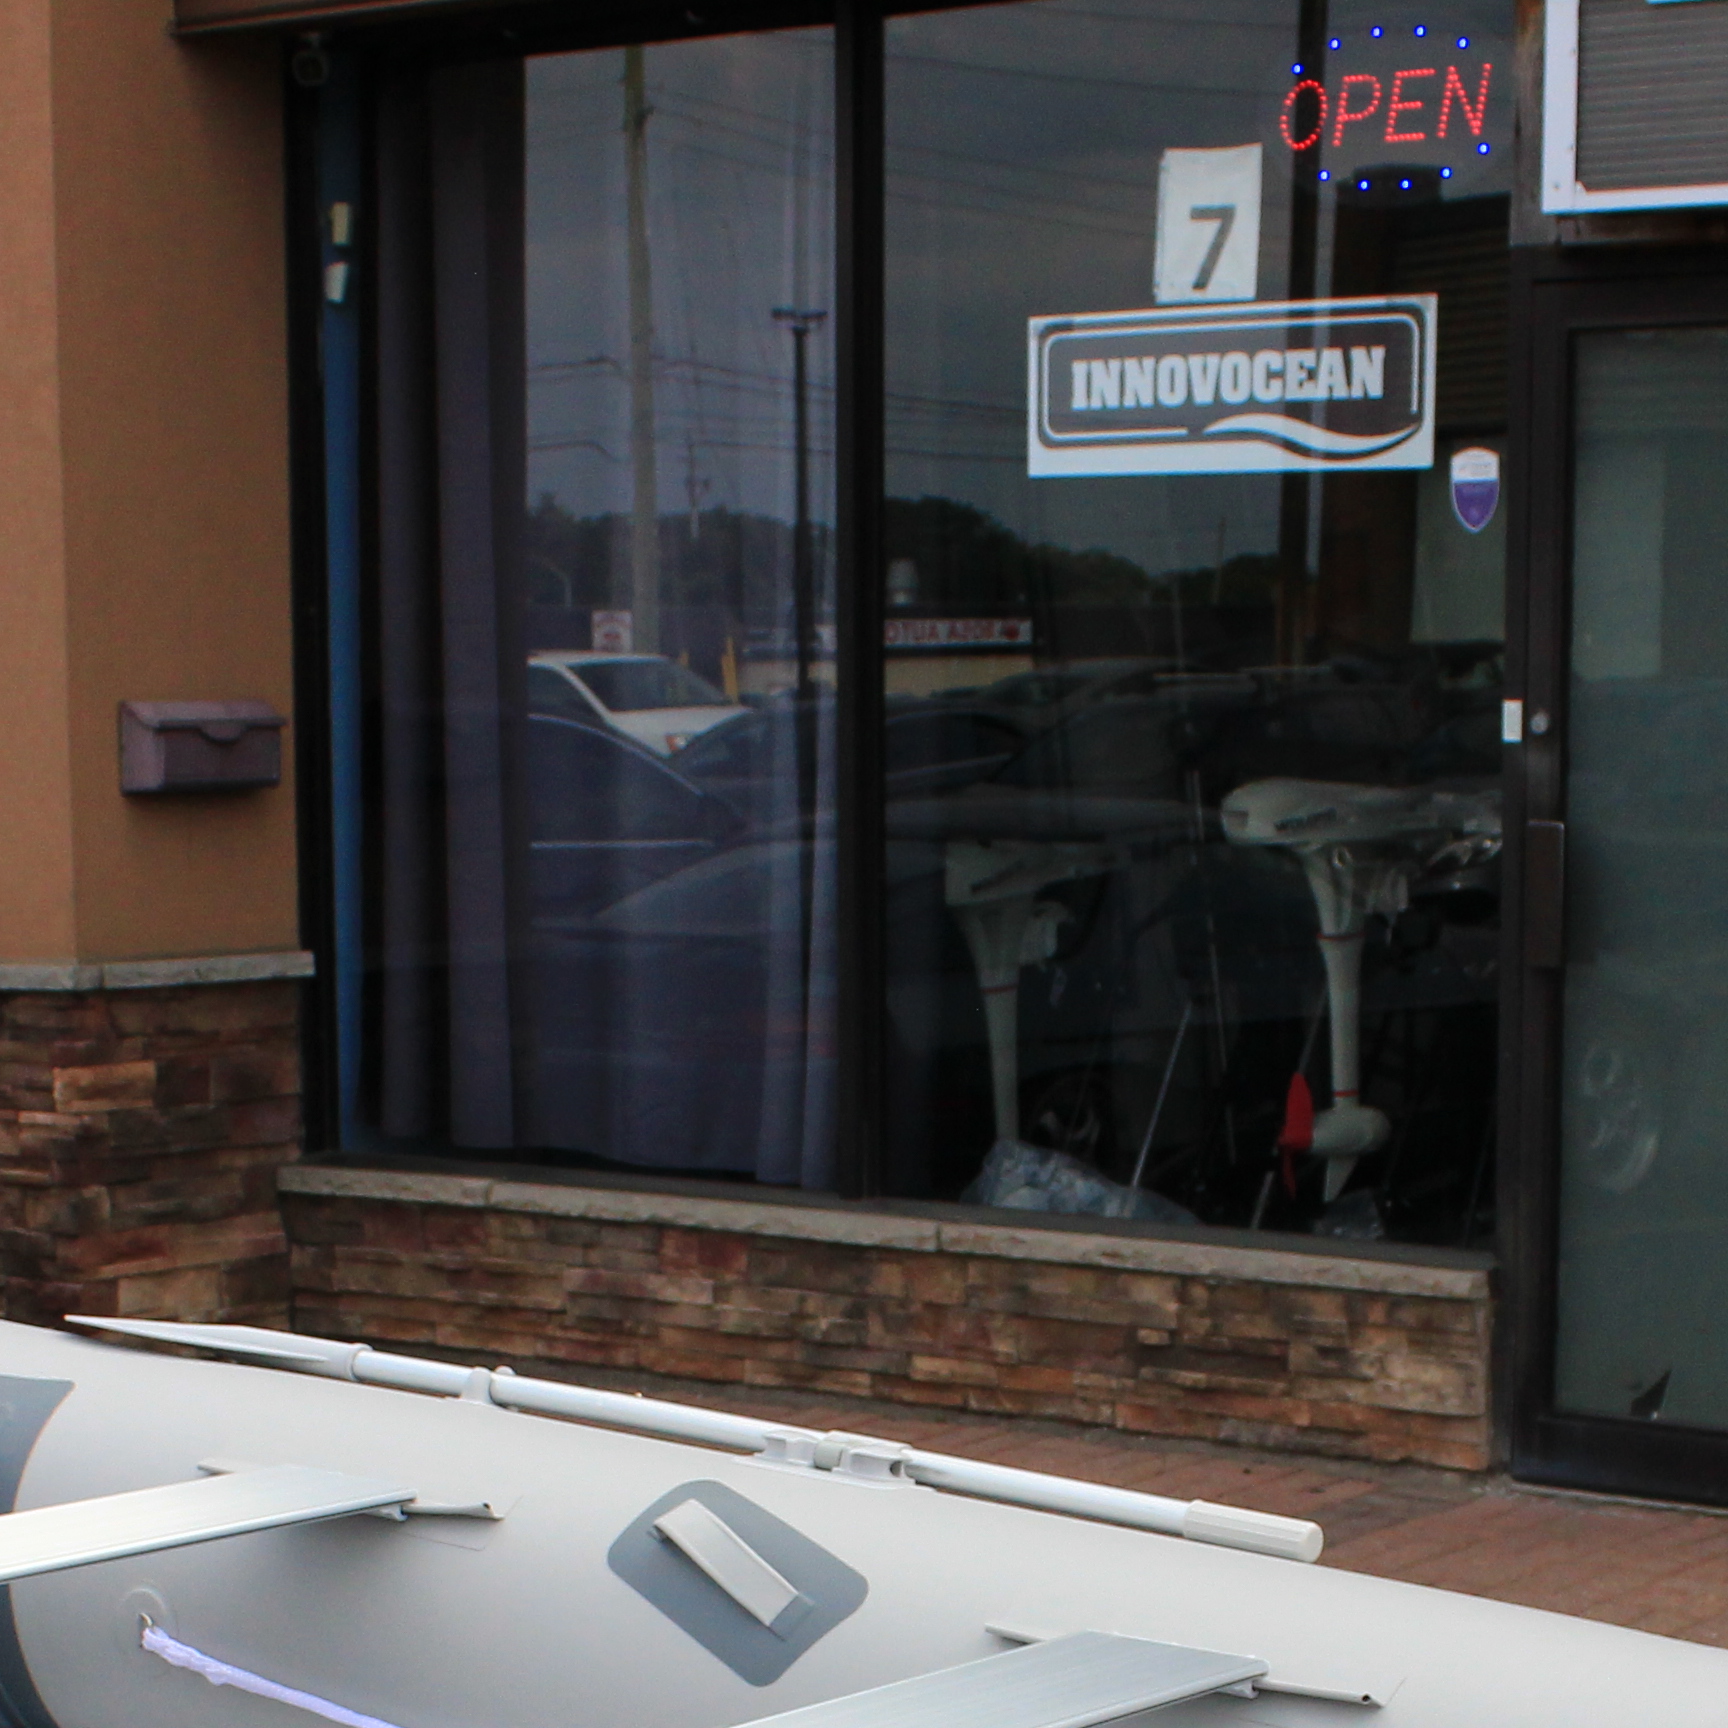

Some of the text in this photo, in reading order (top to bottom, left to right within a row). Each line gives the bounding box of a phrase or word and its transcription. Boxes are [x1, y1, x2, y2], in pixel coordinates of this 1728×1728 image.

[1279, 62, 1493, 150] OPEN
[1190, 203, 1236, 291] 7
[1071, 345, 1386, 412] INNOVOCEAN
